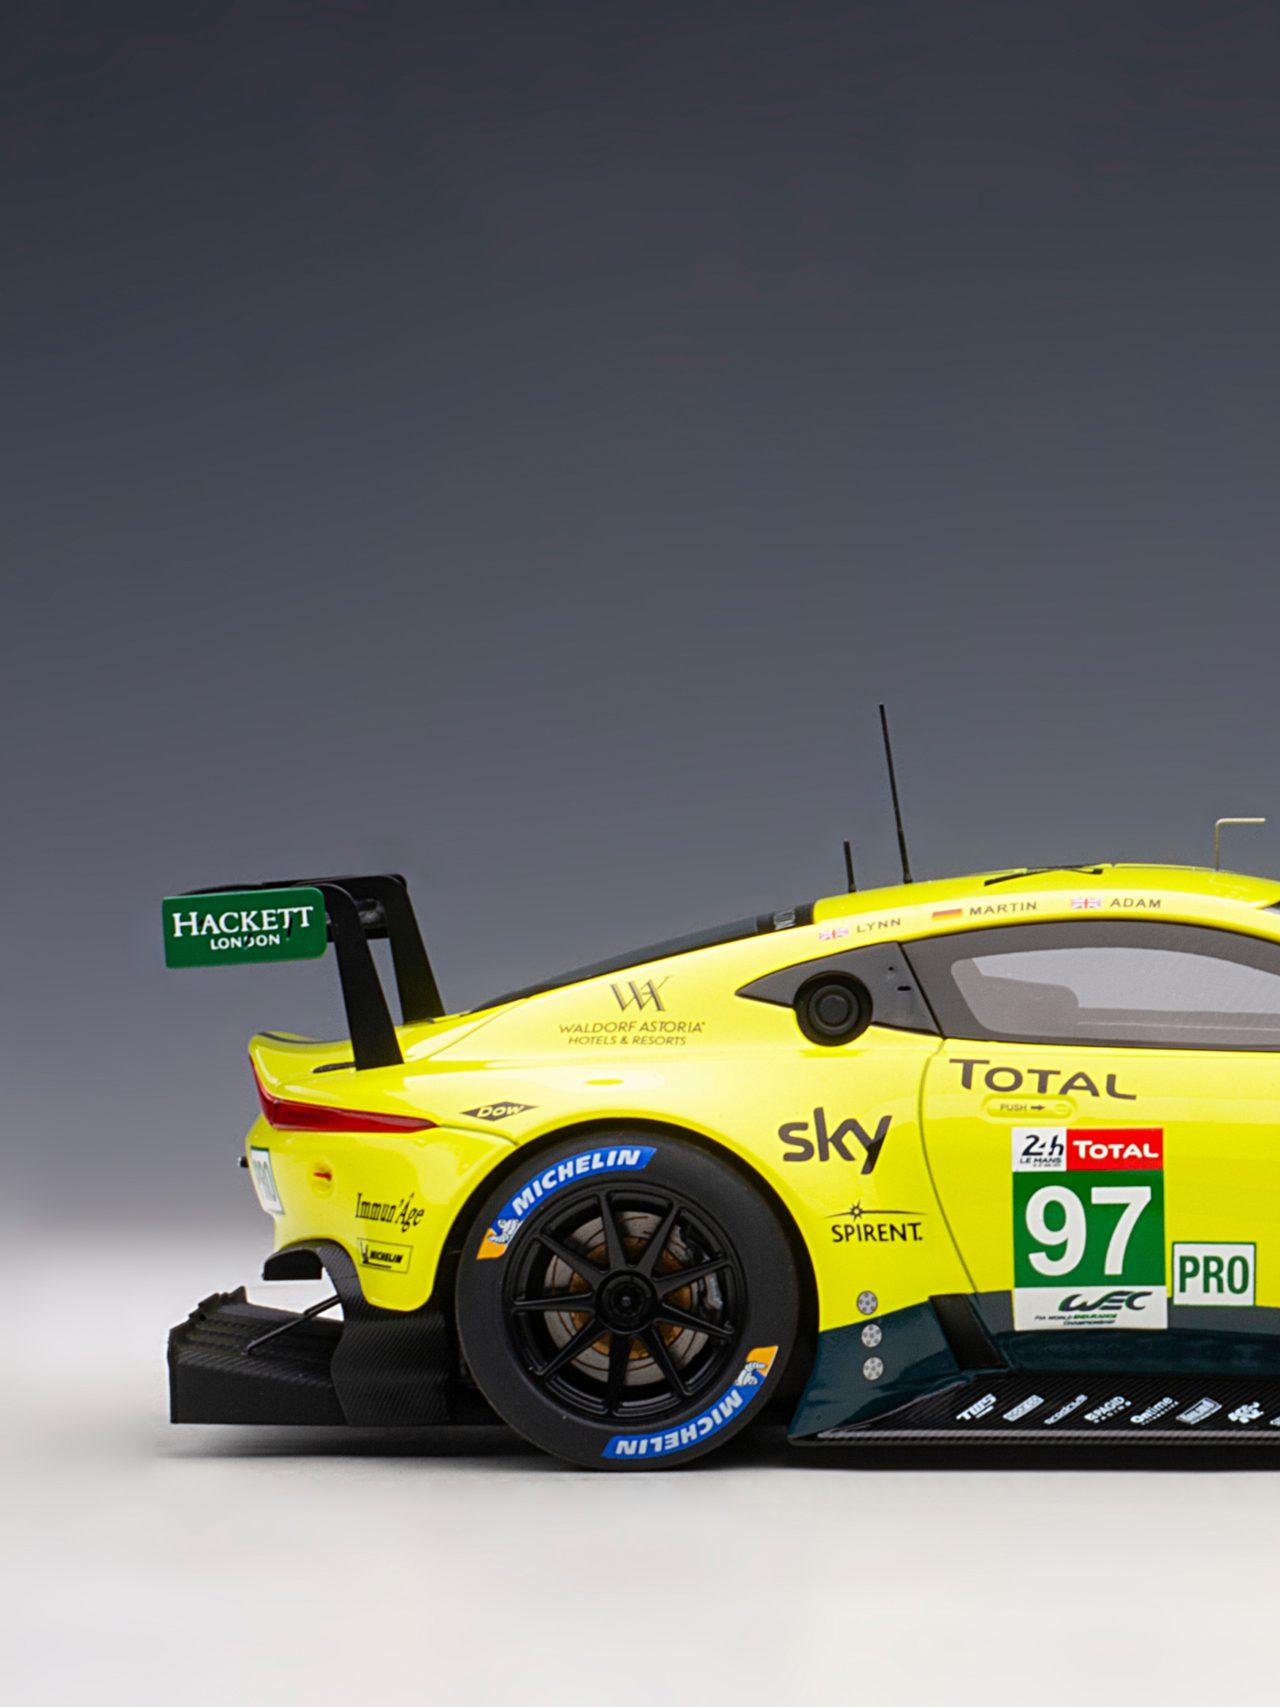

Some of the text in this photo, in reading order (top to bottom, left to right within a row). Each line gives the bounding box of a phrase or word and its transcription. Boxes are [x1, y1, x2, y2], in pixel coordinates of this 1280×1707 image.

[969, 902, 1038, 916] MARTIN
[1110, 898, 1162, 908] ADAM
[172, 906, 314, 937] HACKETT
[856, 918, 901, 933] LYNN
[558, 1020, 637, 1034] WALDORF
[567, 1035, 617, 1045] HOTELS
[632, 1035, 687, 1046] RESORTS
[949, 1058, 1137, 1101] TOTAL
[1000, 1104, 1027, 1112] PUSH
[778, 1107, 893, 1175] sky
[1073, 1139, 1160, 1159] TOTAL
[511, 1150, 641, 1217] MICHELIN
[1025, 1185, 1152, 1276] 97
[1179, 1255, 1249, 1294] PRO
[1058, 1290, 1152, 1312] WEC
[616, 1390, 743, 1454] MICHELIN
